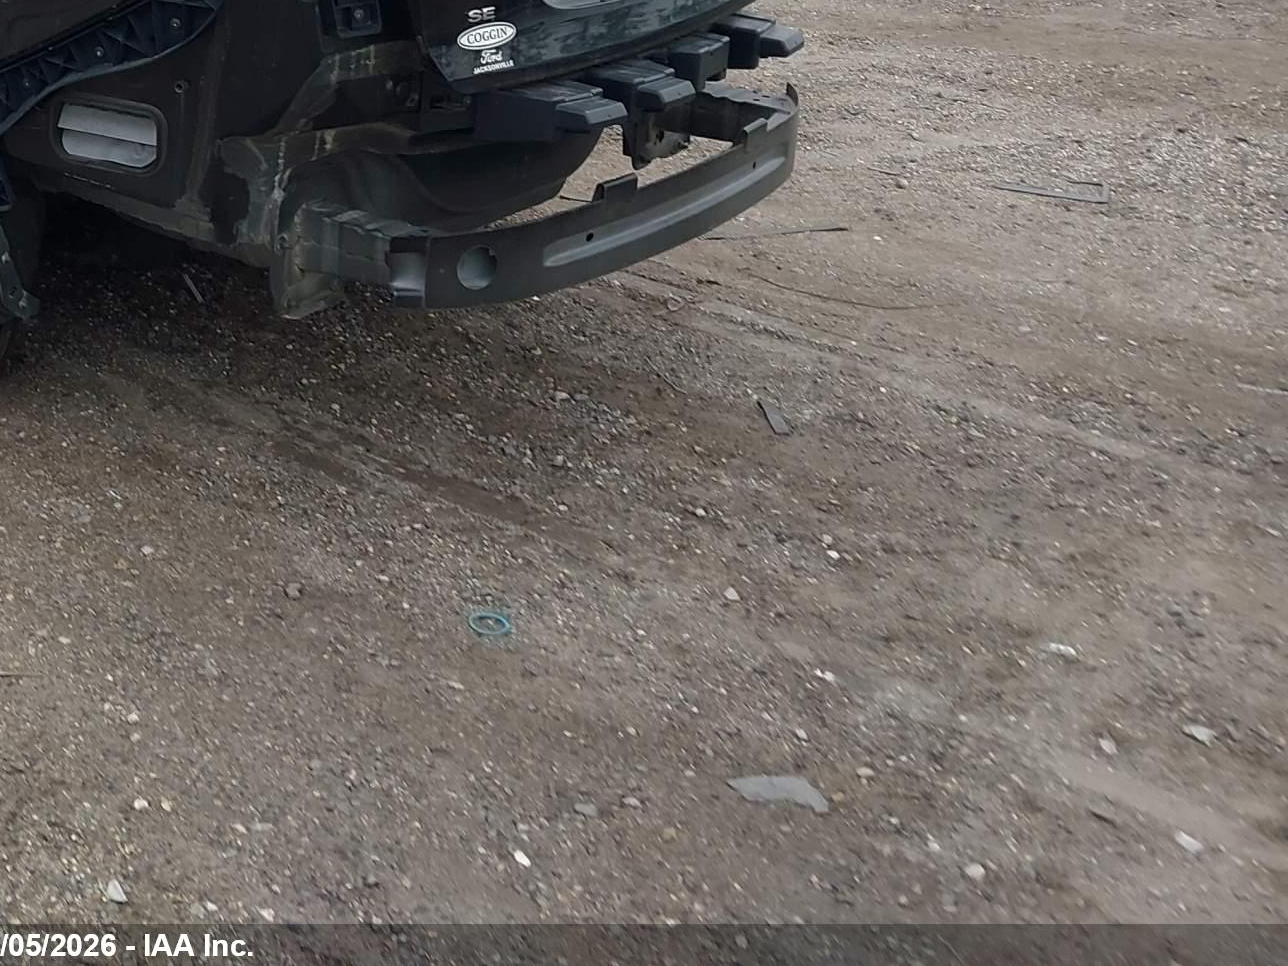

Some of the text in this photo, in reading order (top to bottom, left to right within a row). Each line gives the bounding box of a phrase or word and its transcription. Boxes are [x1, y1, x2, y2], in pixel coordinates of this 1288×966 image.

[467, 6, 496, 23] SE
[466, 27, 508, 44] COGGIN
[480, 49, 503, 64] Ford
[473, 59, 515, 75] JACKSONVILLE
